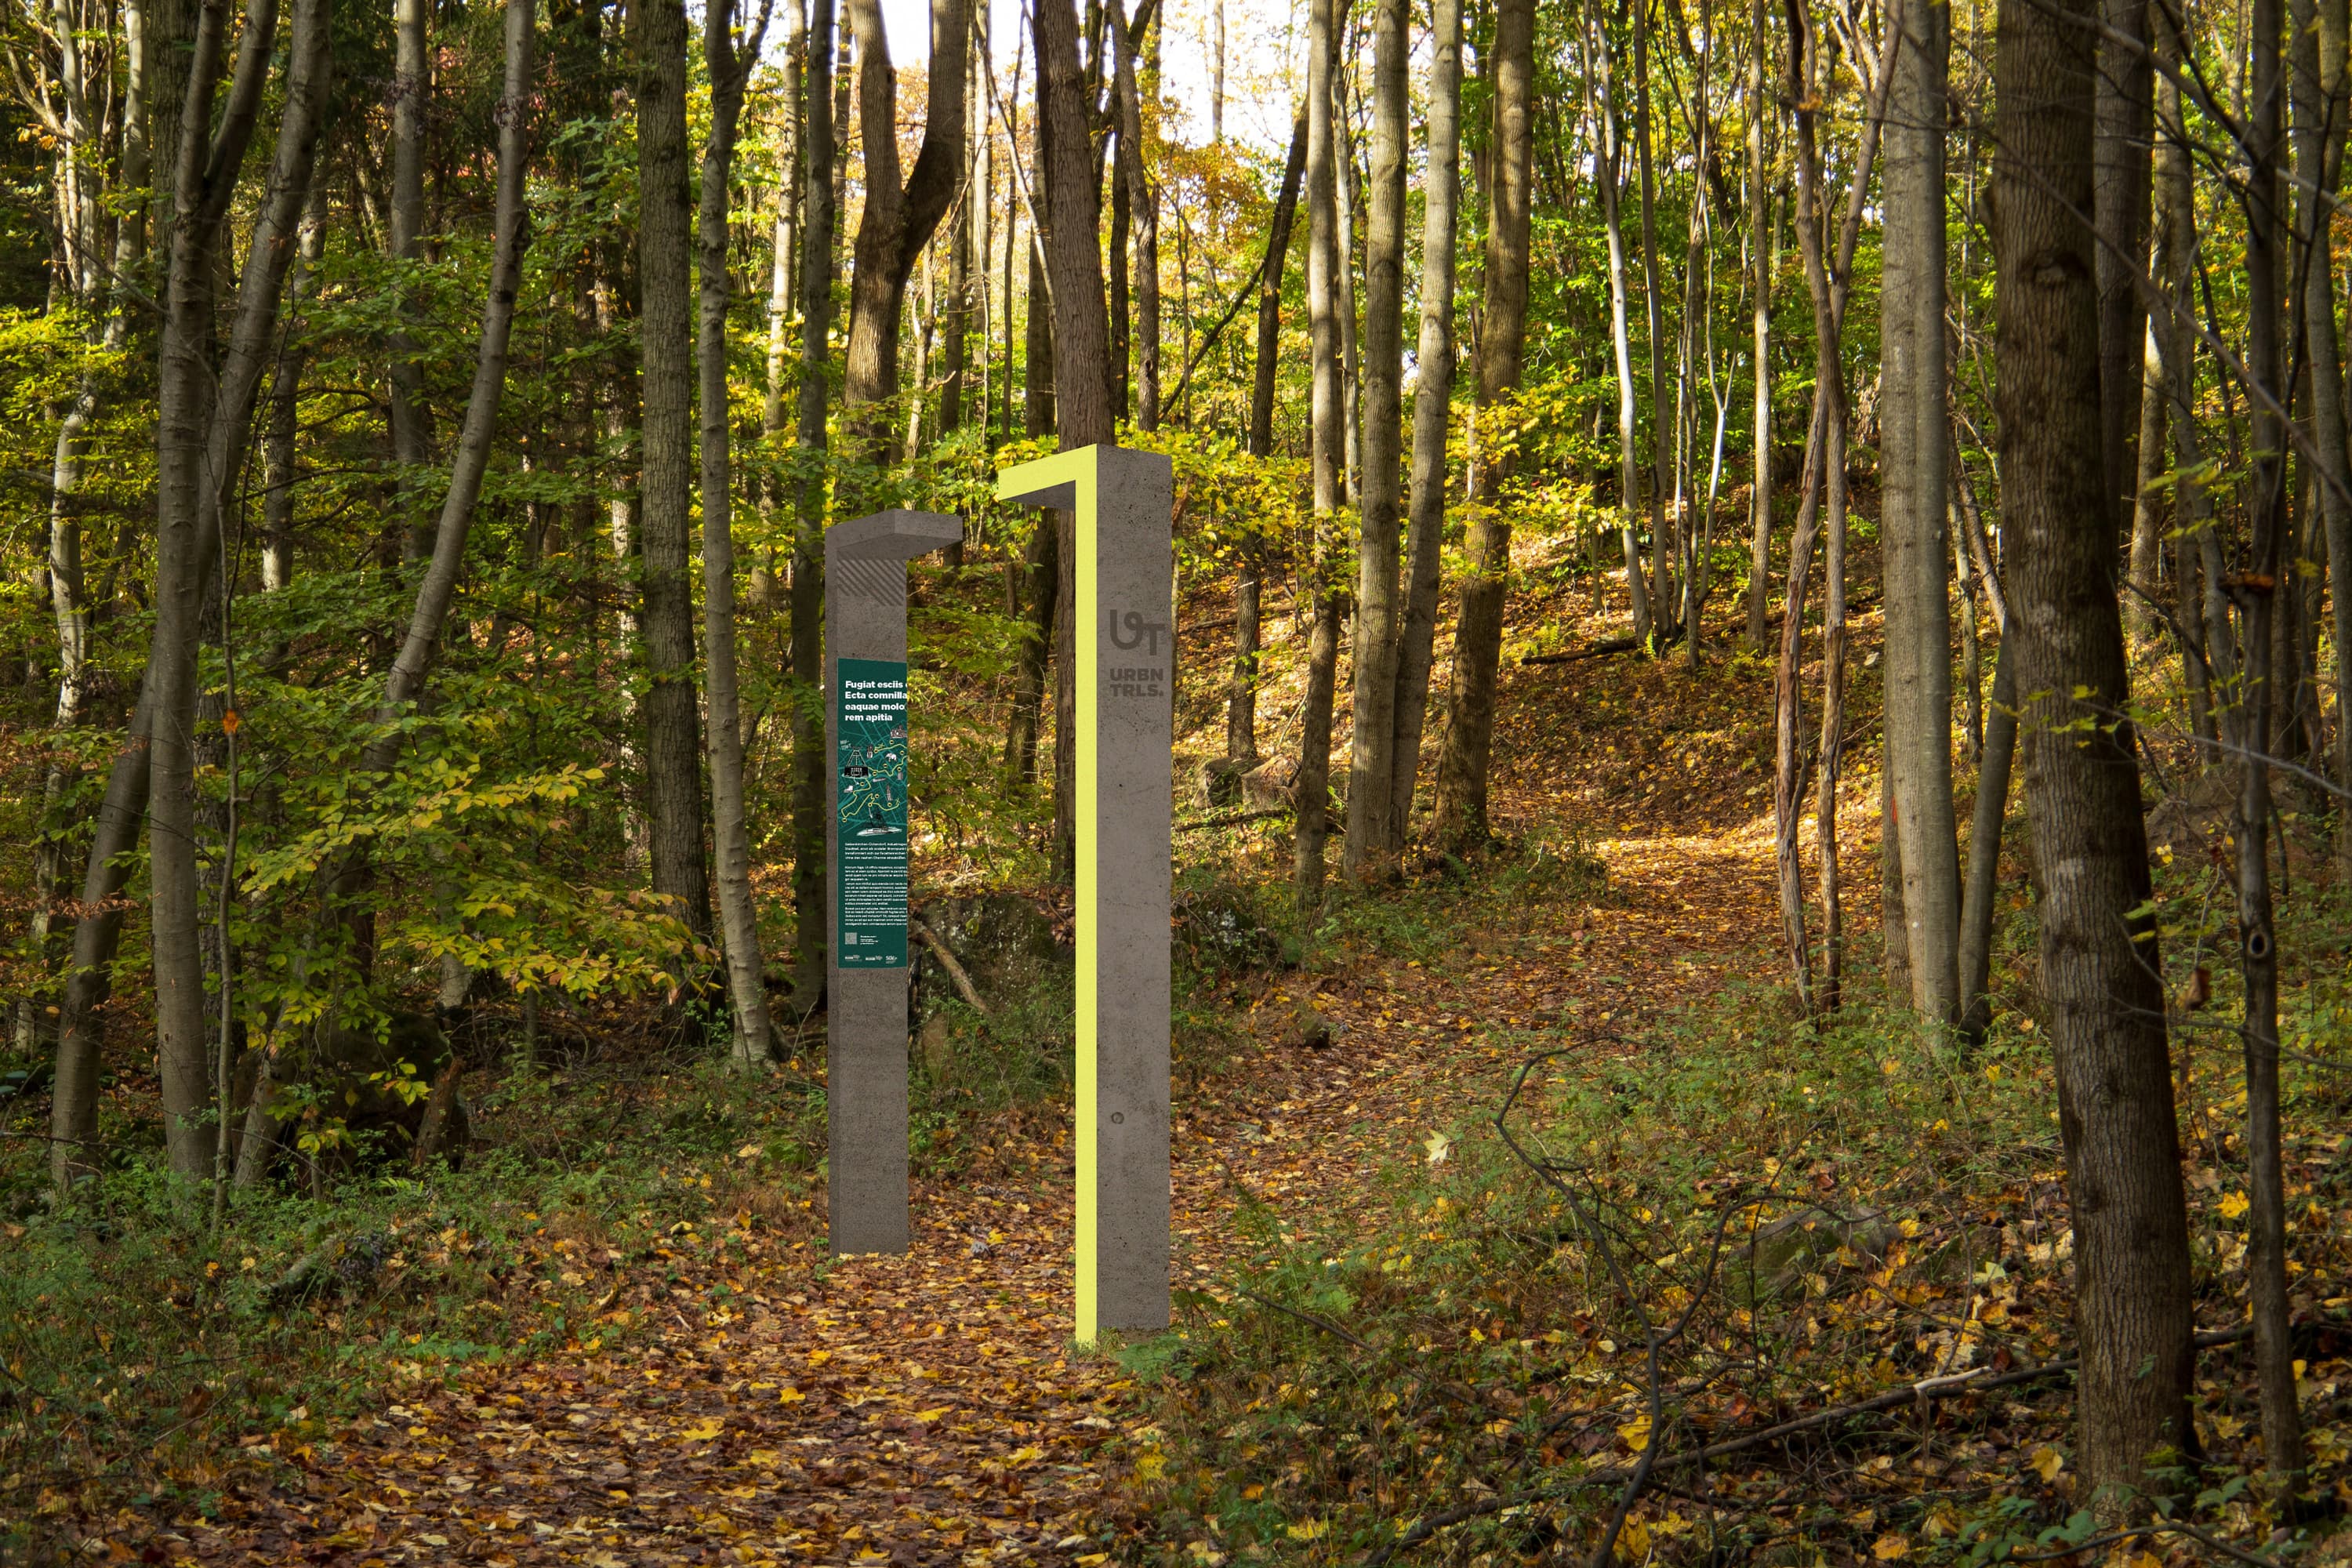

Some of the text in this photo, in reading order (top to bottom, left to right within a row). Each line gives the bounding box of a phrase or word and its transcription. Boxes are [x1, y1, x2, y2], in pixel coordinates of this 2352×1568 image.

[1110, 668, 1163, 681] URBN
[845, 681, 876, 690] Fugiat
[1110, 684, 1164, 697] TRLS.
[866, 713, 893, 723] apitia
